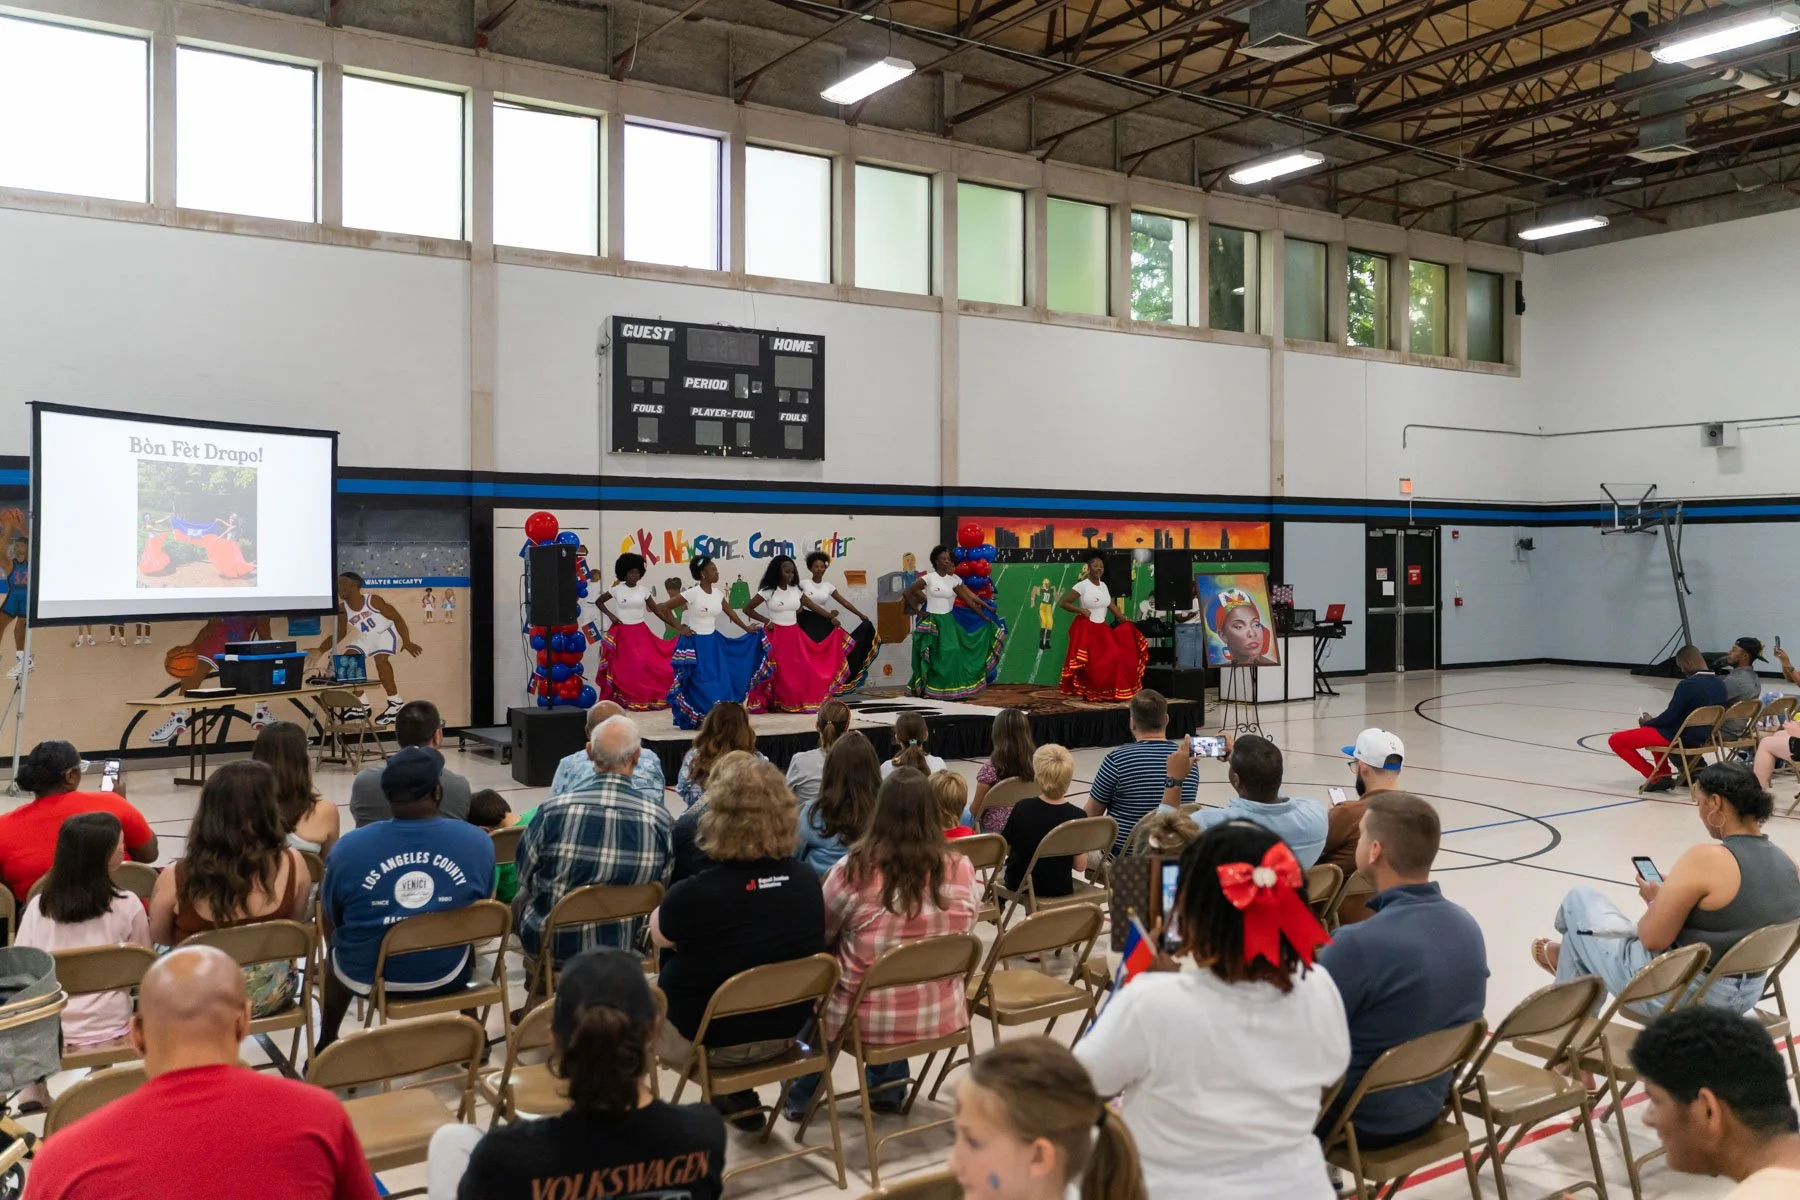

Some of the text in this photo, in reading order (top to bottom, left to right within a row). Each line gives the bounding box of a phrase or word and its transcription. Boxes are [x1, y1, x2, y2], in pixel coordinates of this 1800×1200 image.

[622, 323, 674, 341] GUEST
[773, 338, 815, 353] HOME
[684, 377, 728, 391] PERIOD
[632, 403, 663, 414] FOULS
[691, 407, 754, 420] PLAYER-FOUL
[780, 412, 808, 422] FOULS
[129, 436, 263, 465] Bòn Fèt Drapo!
[360, 617, 376, 633] 40
[361, 851, 467, 890] LOS ANGELES COUNTY
[402, 879, 427, 891] VENICE
[531, 1151, 710, 1200] VOLKSWAGEN
